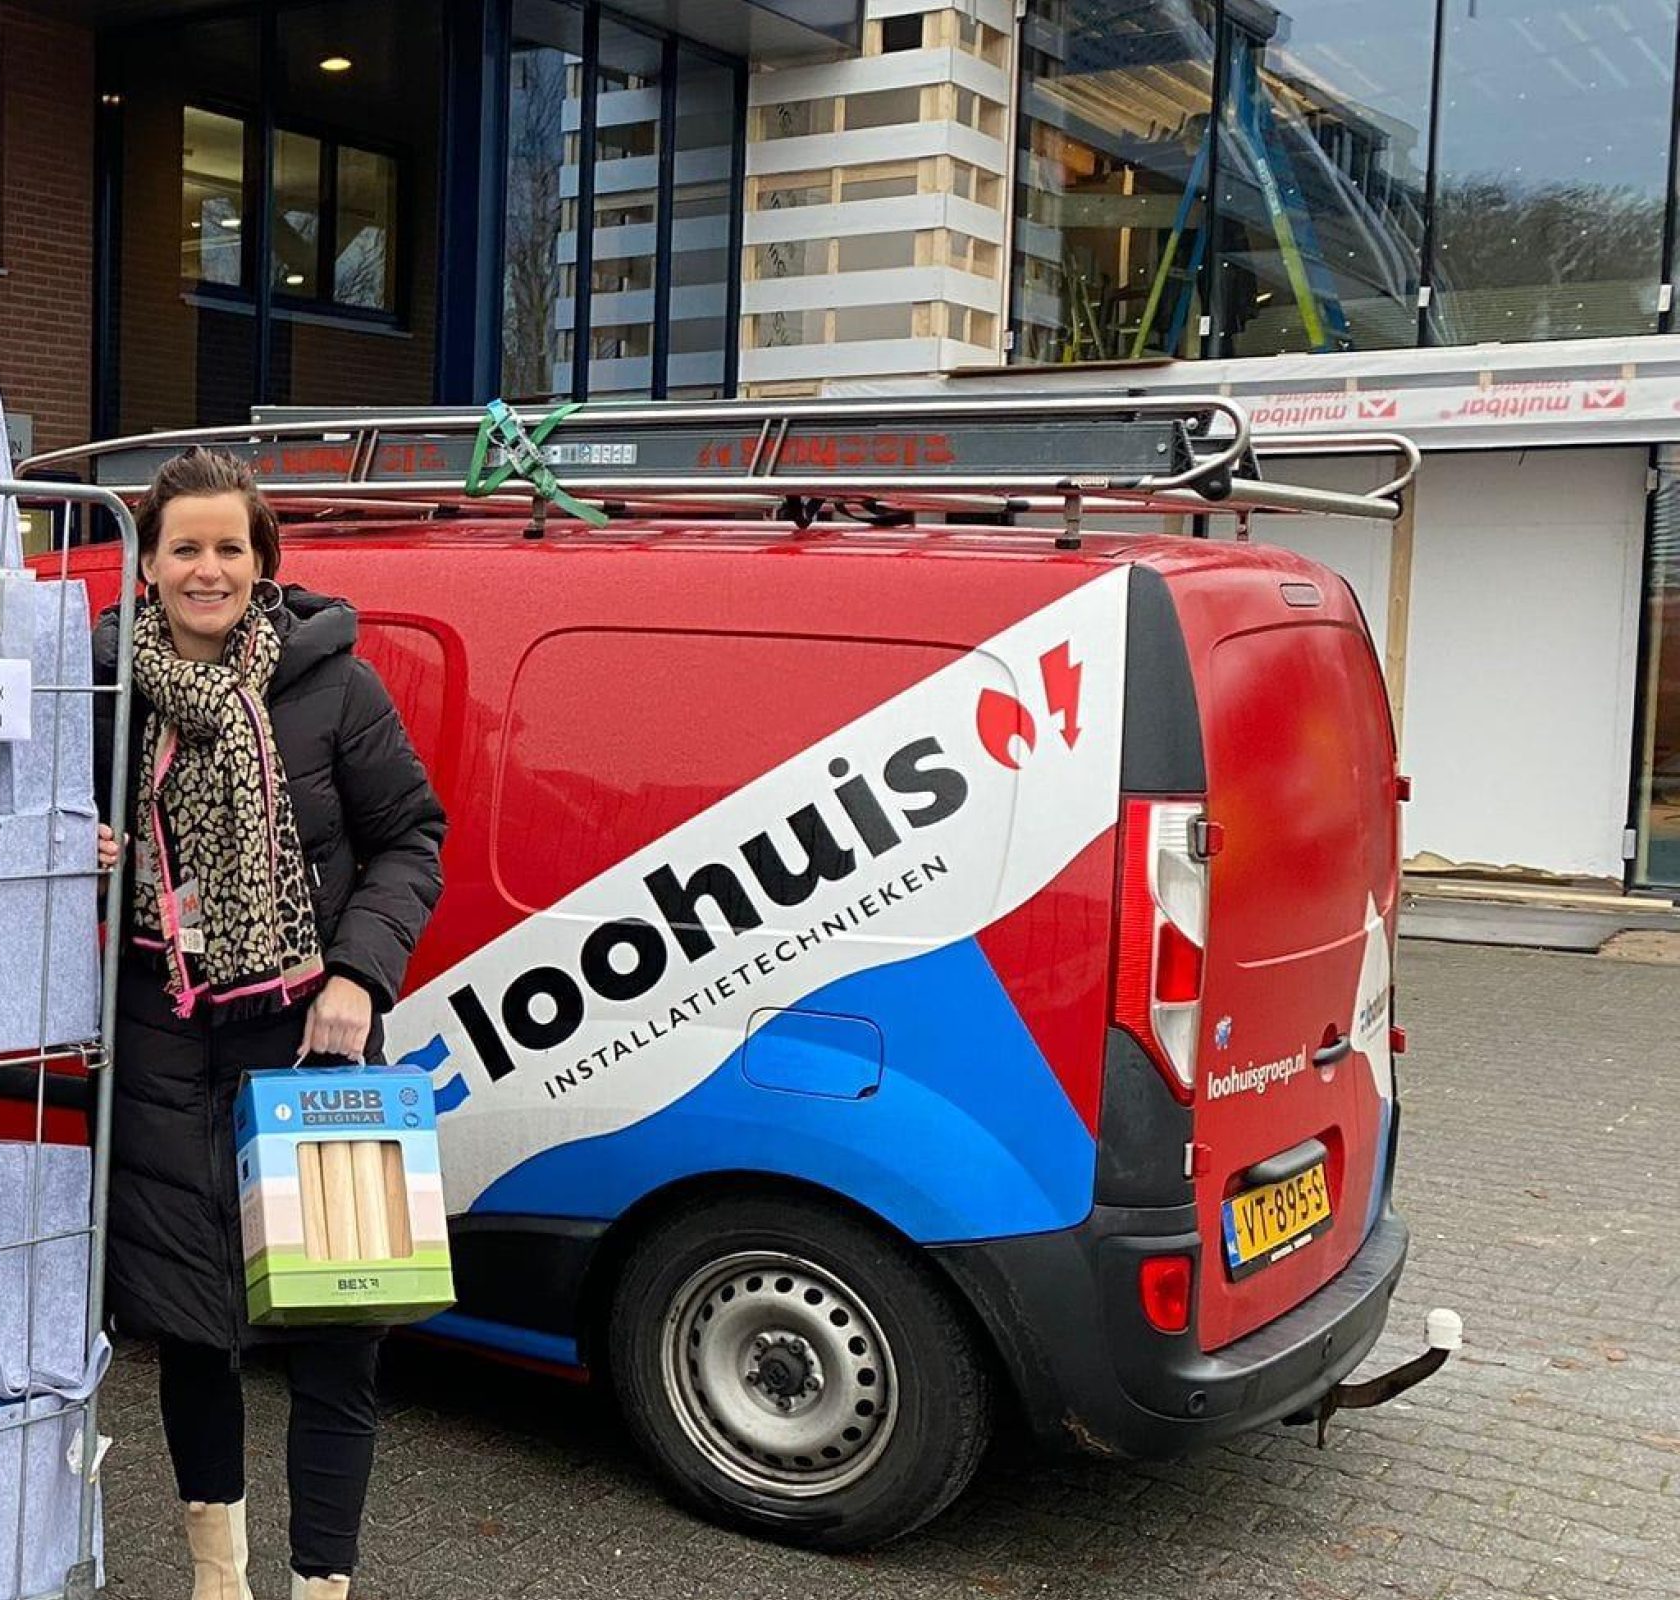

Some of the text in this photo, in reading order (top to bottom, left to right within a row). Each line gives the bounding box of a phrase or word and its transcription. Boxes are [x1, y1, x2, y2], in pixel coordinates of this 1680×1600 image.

[448, 735, 969, 1081] loohuis
[544, 855, 949, 1100] INSTALLATIETECHNIEKEN
[300, 1089, 382, 1110] KUBB
[1208, 1044, 1306, 1099] loohuisgroep.nl
[306, 1113, 381, 1124] ORIGINAL
[1242, 1169, 1323, 1247] VT-895-S
